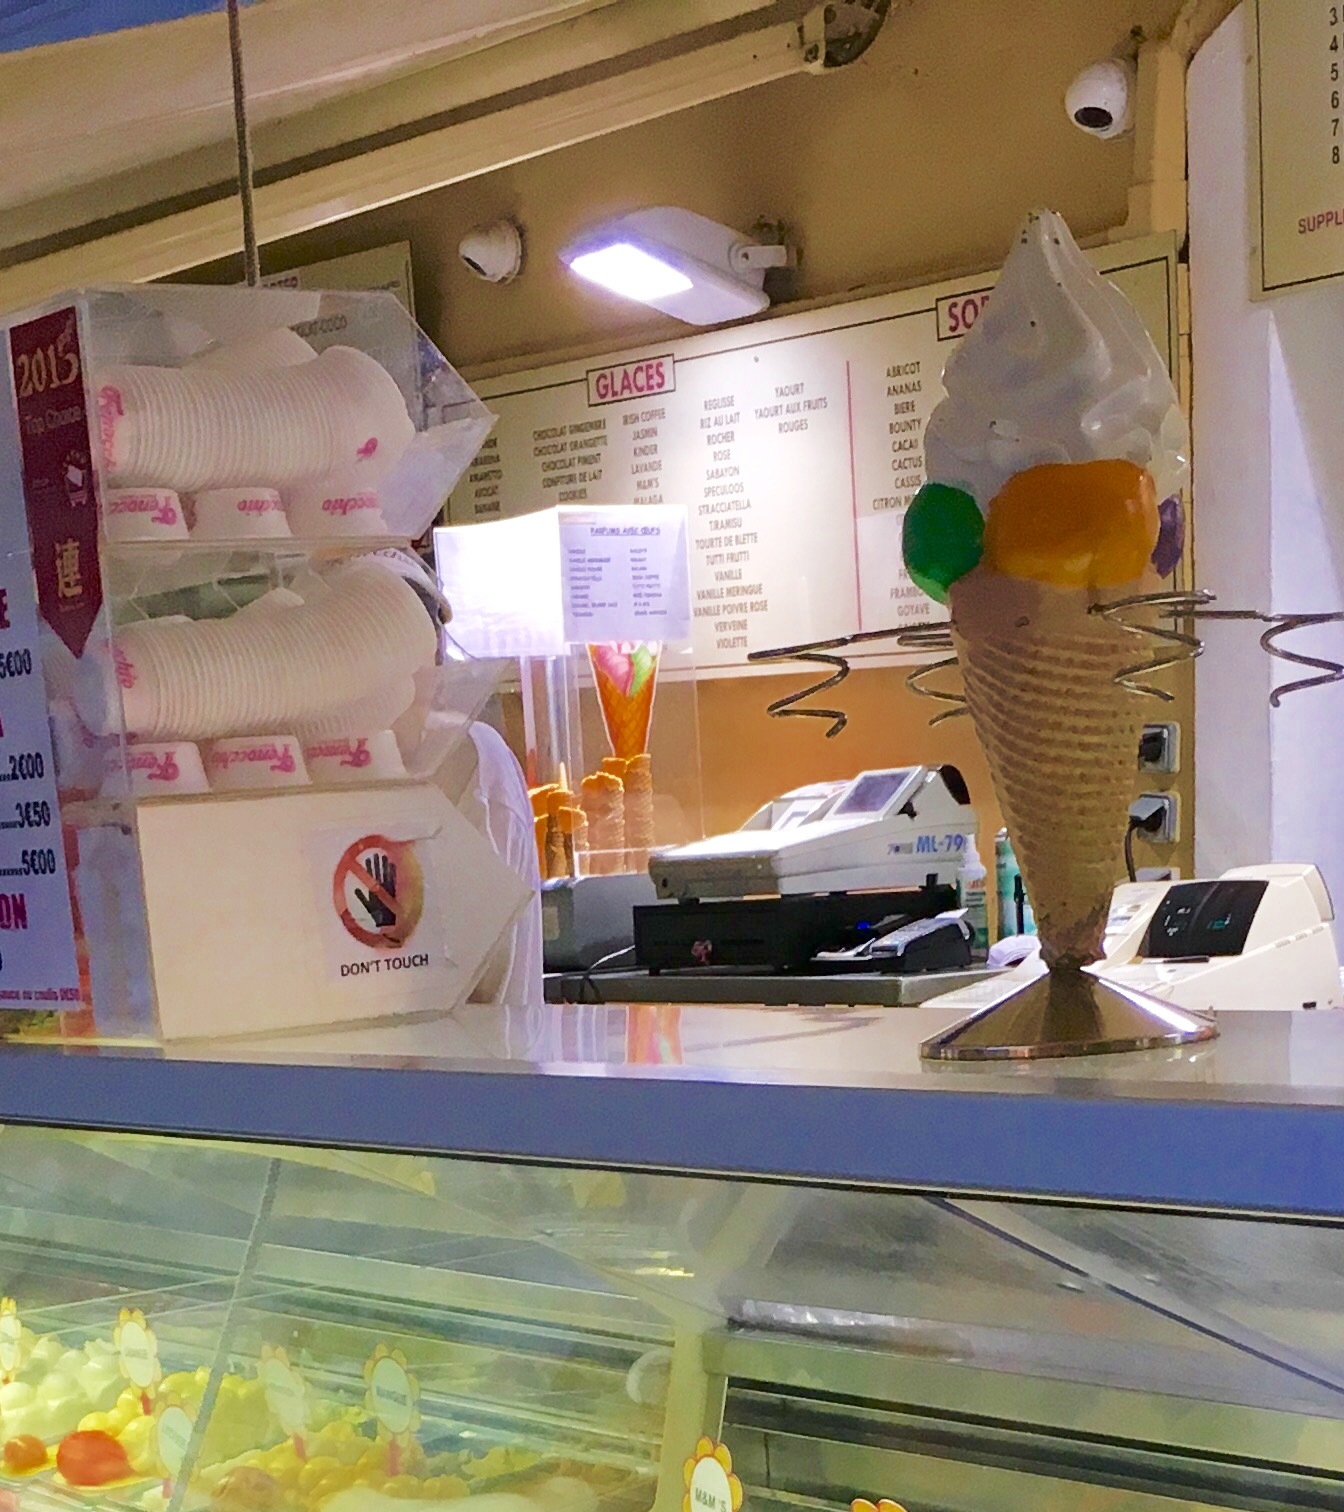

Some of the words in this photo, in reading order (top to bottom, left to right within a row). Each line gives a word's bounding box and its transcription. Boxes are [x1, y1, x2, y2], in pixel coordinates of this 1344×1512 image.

[1329, 7, 1338, 26] 3
[1329, 34, 1338, 53] 4
[1330, 62, 1339, 82] 5
[1331, 91, 1339, 109] 6
[1331, 118, 1339, 137] 7
[1331, 145, 1340, 164] 8
[948, 295, 990, 333] SO
[886, 361, 921, 378] ABRICOT
[595, 361, 666, 400] GLACES
[886, 380, 923, 398] ANANAS
[774, 382, 805, 399] YAOURT
[640, 407, 666, 423] COFFEE
[754, 403, 783, 420] YAOURT
[785, 401, 802, 416] AUX
[803, 396, 828, 412] FRUITS
[713, 414, 724, 428] AU
[725, 411, 741, 426] LAIT
[778, 418, 809, 435] ROUGES
[888, 418, 923, 435] BOUNTY
[632, 427, 658, 442] JASMIN
[706, 430, 736, 446] ROCHER
[633, 444, 659, 458] KINDER
[891, 438, 919, 453] CACAO
[712, 448, 731, 462] ROSE
[891, 455, 923, 472] CACTUS
[631, 459, 663, 476] LAVANDE
[705, 465, 740, 481] SABAYON
[703, 482, 745, 499] SPECULOOS
[894, 474, 922, 490] CASSIS
[697, 498, 752, 516] STRACCIATELLA
[872, 496, 903, 511] CITRON
[708, 517, 743, 532] TIRAMISU
[695, 535, 723, 550] TOURTE
[723, 534, 734, 547] DE
[734, 531, 759, 546] BLETTE
[705, 552, 725, 566] TUTTI
[726, 550, 750, 564] FRUTTI
[714, 568, 743, 581] VANILLE
[696, 586, 725, 601] VANILLE
[725, 583, 763, 598] MERINGUE
[693, 603, 721, 618] VANILLE
[722, 601, 748, 615] POIVRE
[749, 599, 769, 613] ROSE
[897, 602, 930, 617] GOYAVE
[714, 618, 748, 633] VERVEINE
[716, 635, 748, 650] VIOLETTE
[8, 752, 45, 781] 2€00
[21, 848, 57, 877] 5€00
[340, 959, 382, 977] DON'T
[384, 953, 430, 971] TOUCH
